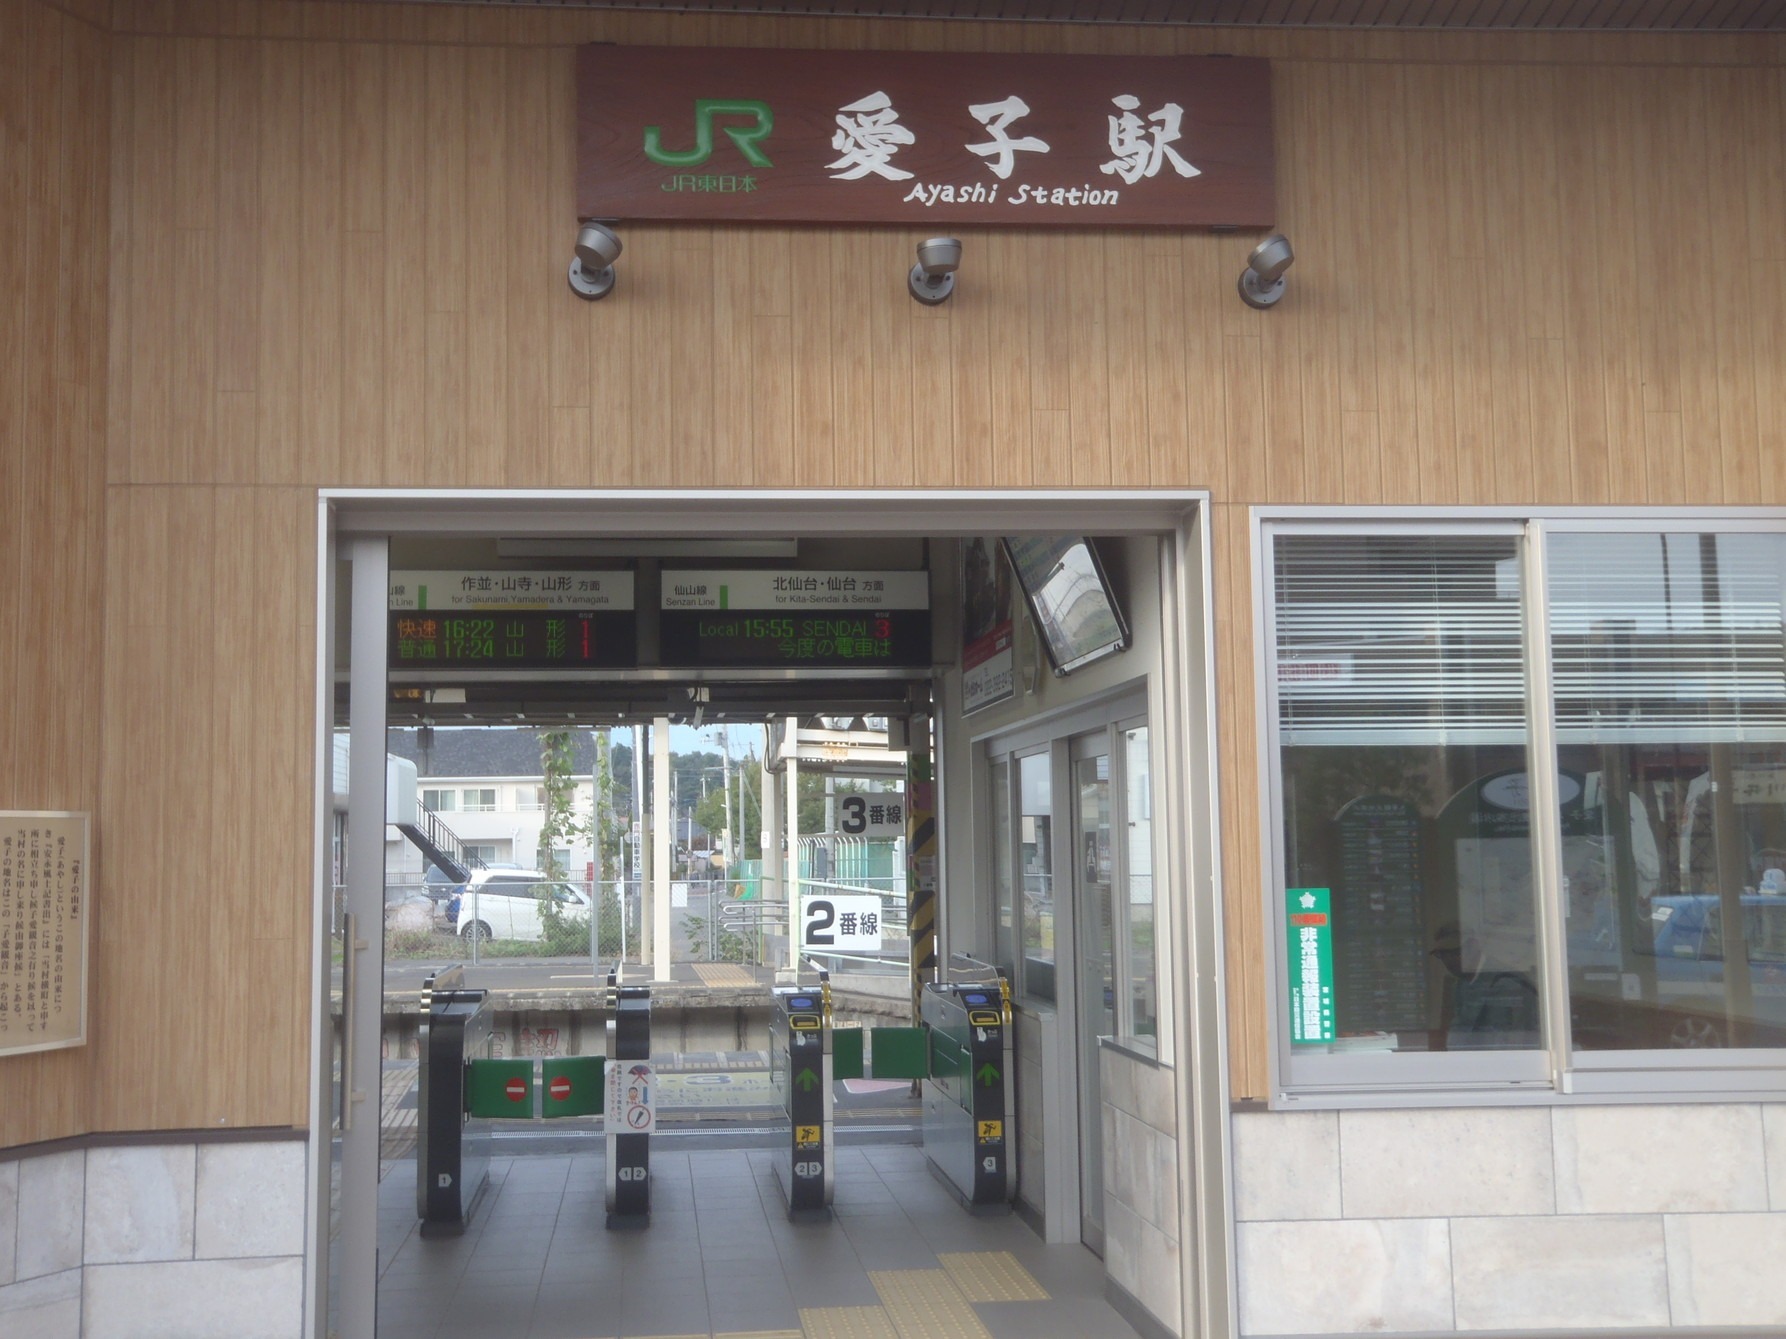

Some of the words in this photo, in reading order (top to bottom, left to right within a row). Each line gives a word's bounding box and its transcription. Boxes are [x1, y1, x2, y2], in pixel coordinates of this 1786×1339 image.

[644, 99, 774, 168] JR
[823, 91, 1202, 184] 愛子駅
[661, 174, 758, 193] JR東日本
[903, 182, 998, 206] Ayashi
[1009, 184, 1119, 206] Station
[461, 576, 573, 592] 作並・山寺・山形
[578, 580, 600, 591] 方面
[674, 585, 707, 596] 仙山線
[773, 577, 857, 591] 北仙台・仙台
[862, 581, 884, 591] 方面
[665, 598, 696, 606] Senzan
[698, 598, 715, 606] Line
[776, 594, 787, 603] for
[790, 594, 840, 603] Kita-Sendai
[842, 595, 848, 603] &
[851, 594, 882, 603] Sendai
[397, 618, 437, 638] 快速
[444, 620, 495, 638] 16:22
[581, 621, 589, 638] 1
[699, 620, 739, 637] Local
[743, 619, 794, 638] 15:55
[802, 620, 866, 637] SENDAI
[875, 619, 891, 638] 3
[397, 640, 437, 658] 普通
[444, 641, 495, 658] 17:24
[581, 640, 589, 658] 1
[777, 638, 892, 658] 今度の電車は
[842, 796, 902, 834] 3番線
[805, 900, 878, 945] 2番線
[799, 1164, 805, 1172] 2
[811, 1164, 817, 1172] 3
